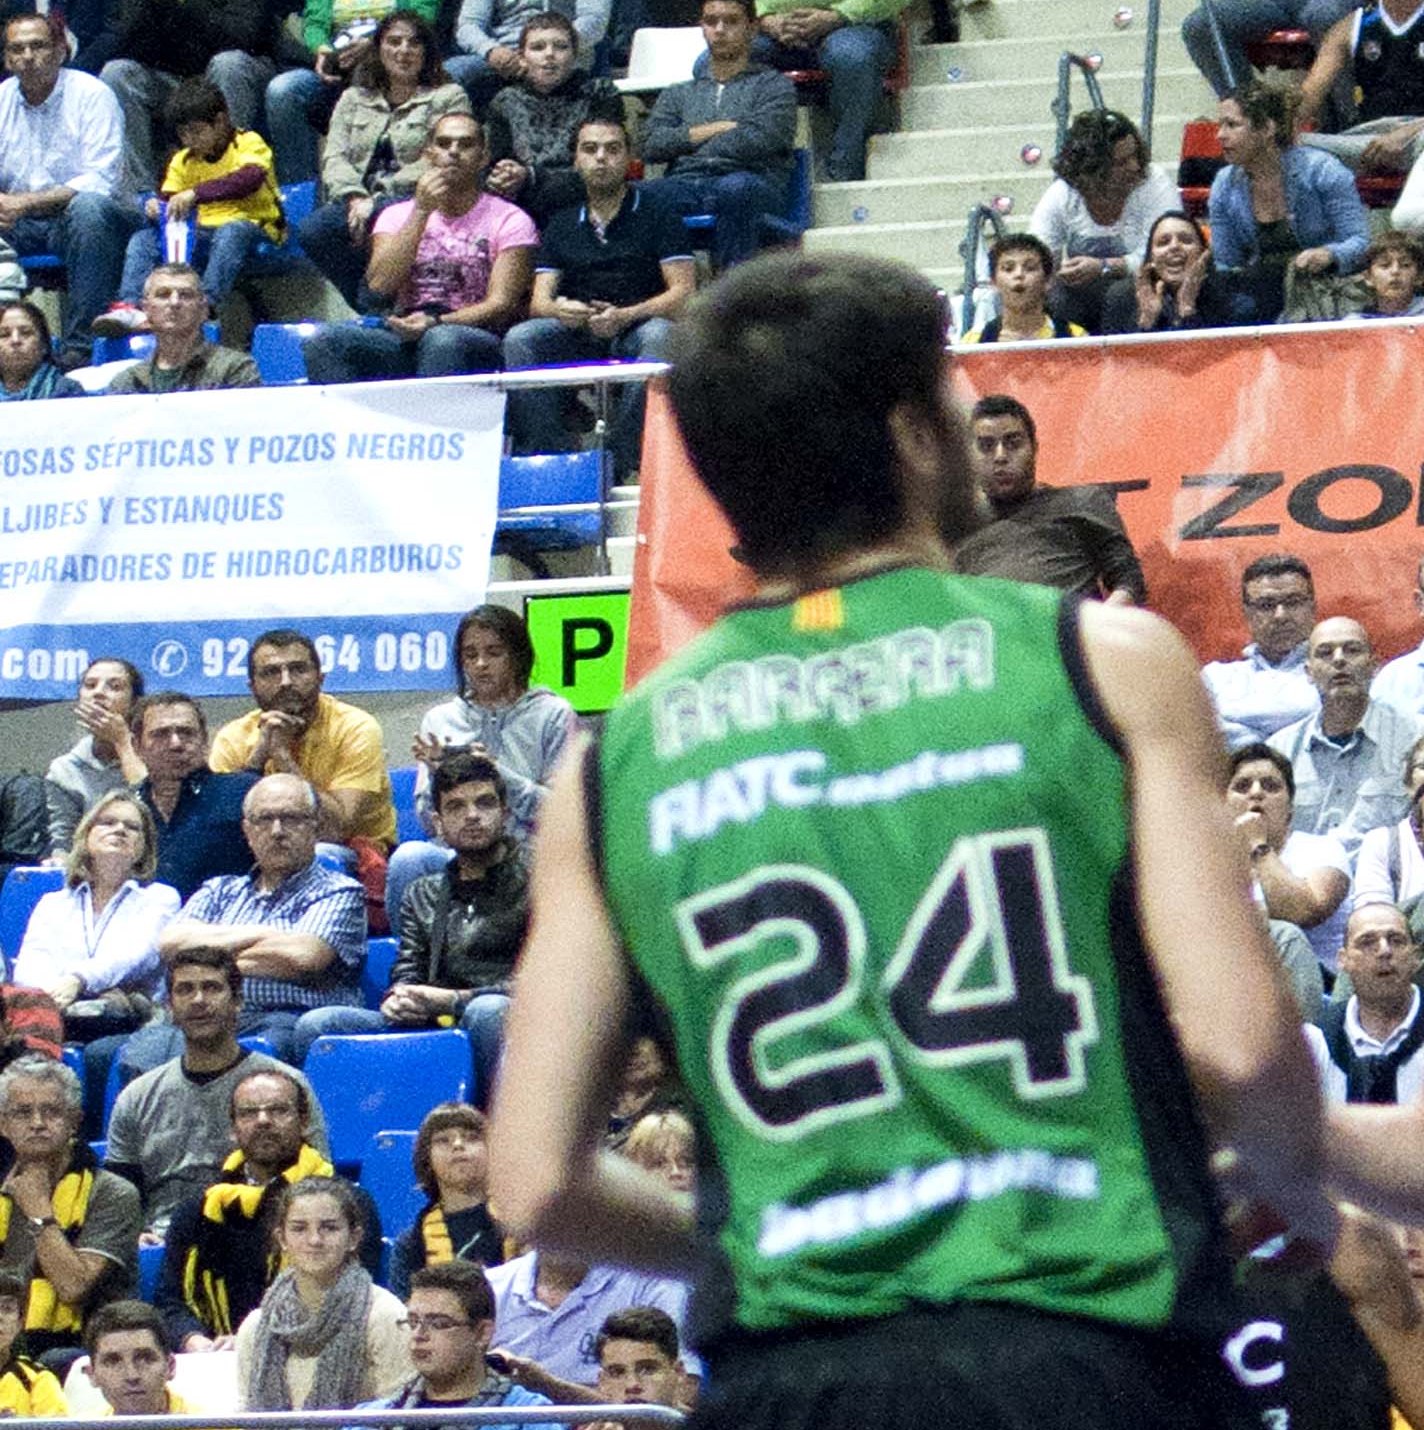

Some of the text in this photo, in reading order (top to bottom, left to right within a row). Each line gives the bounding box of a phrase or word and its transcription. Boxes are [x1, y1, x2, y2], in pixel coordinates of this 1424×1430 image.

[84, 436, 216, 472] SÉPTICAS
[224, 436, 241, 465] Y
[248, 432, 337, 465] POZOS
[346, 432, 466, 461] NEGROS
[99, 495, 115, 525] Y
[124, 492, 285, 525] ESTANQUES
[182, 551, 218, 580] DE
[226, 543, 464, 579] HIDROCARBUROS
[374, 630, 447, 672] 060
[562, 617, 614, 687] P
[675, 826, 1101, 1143] 24
